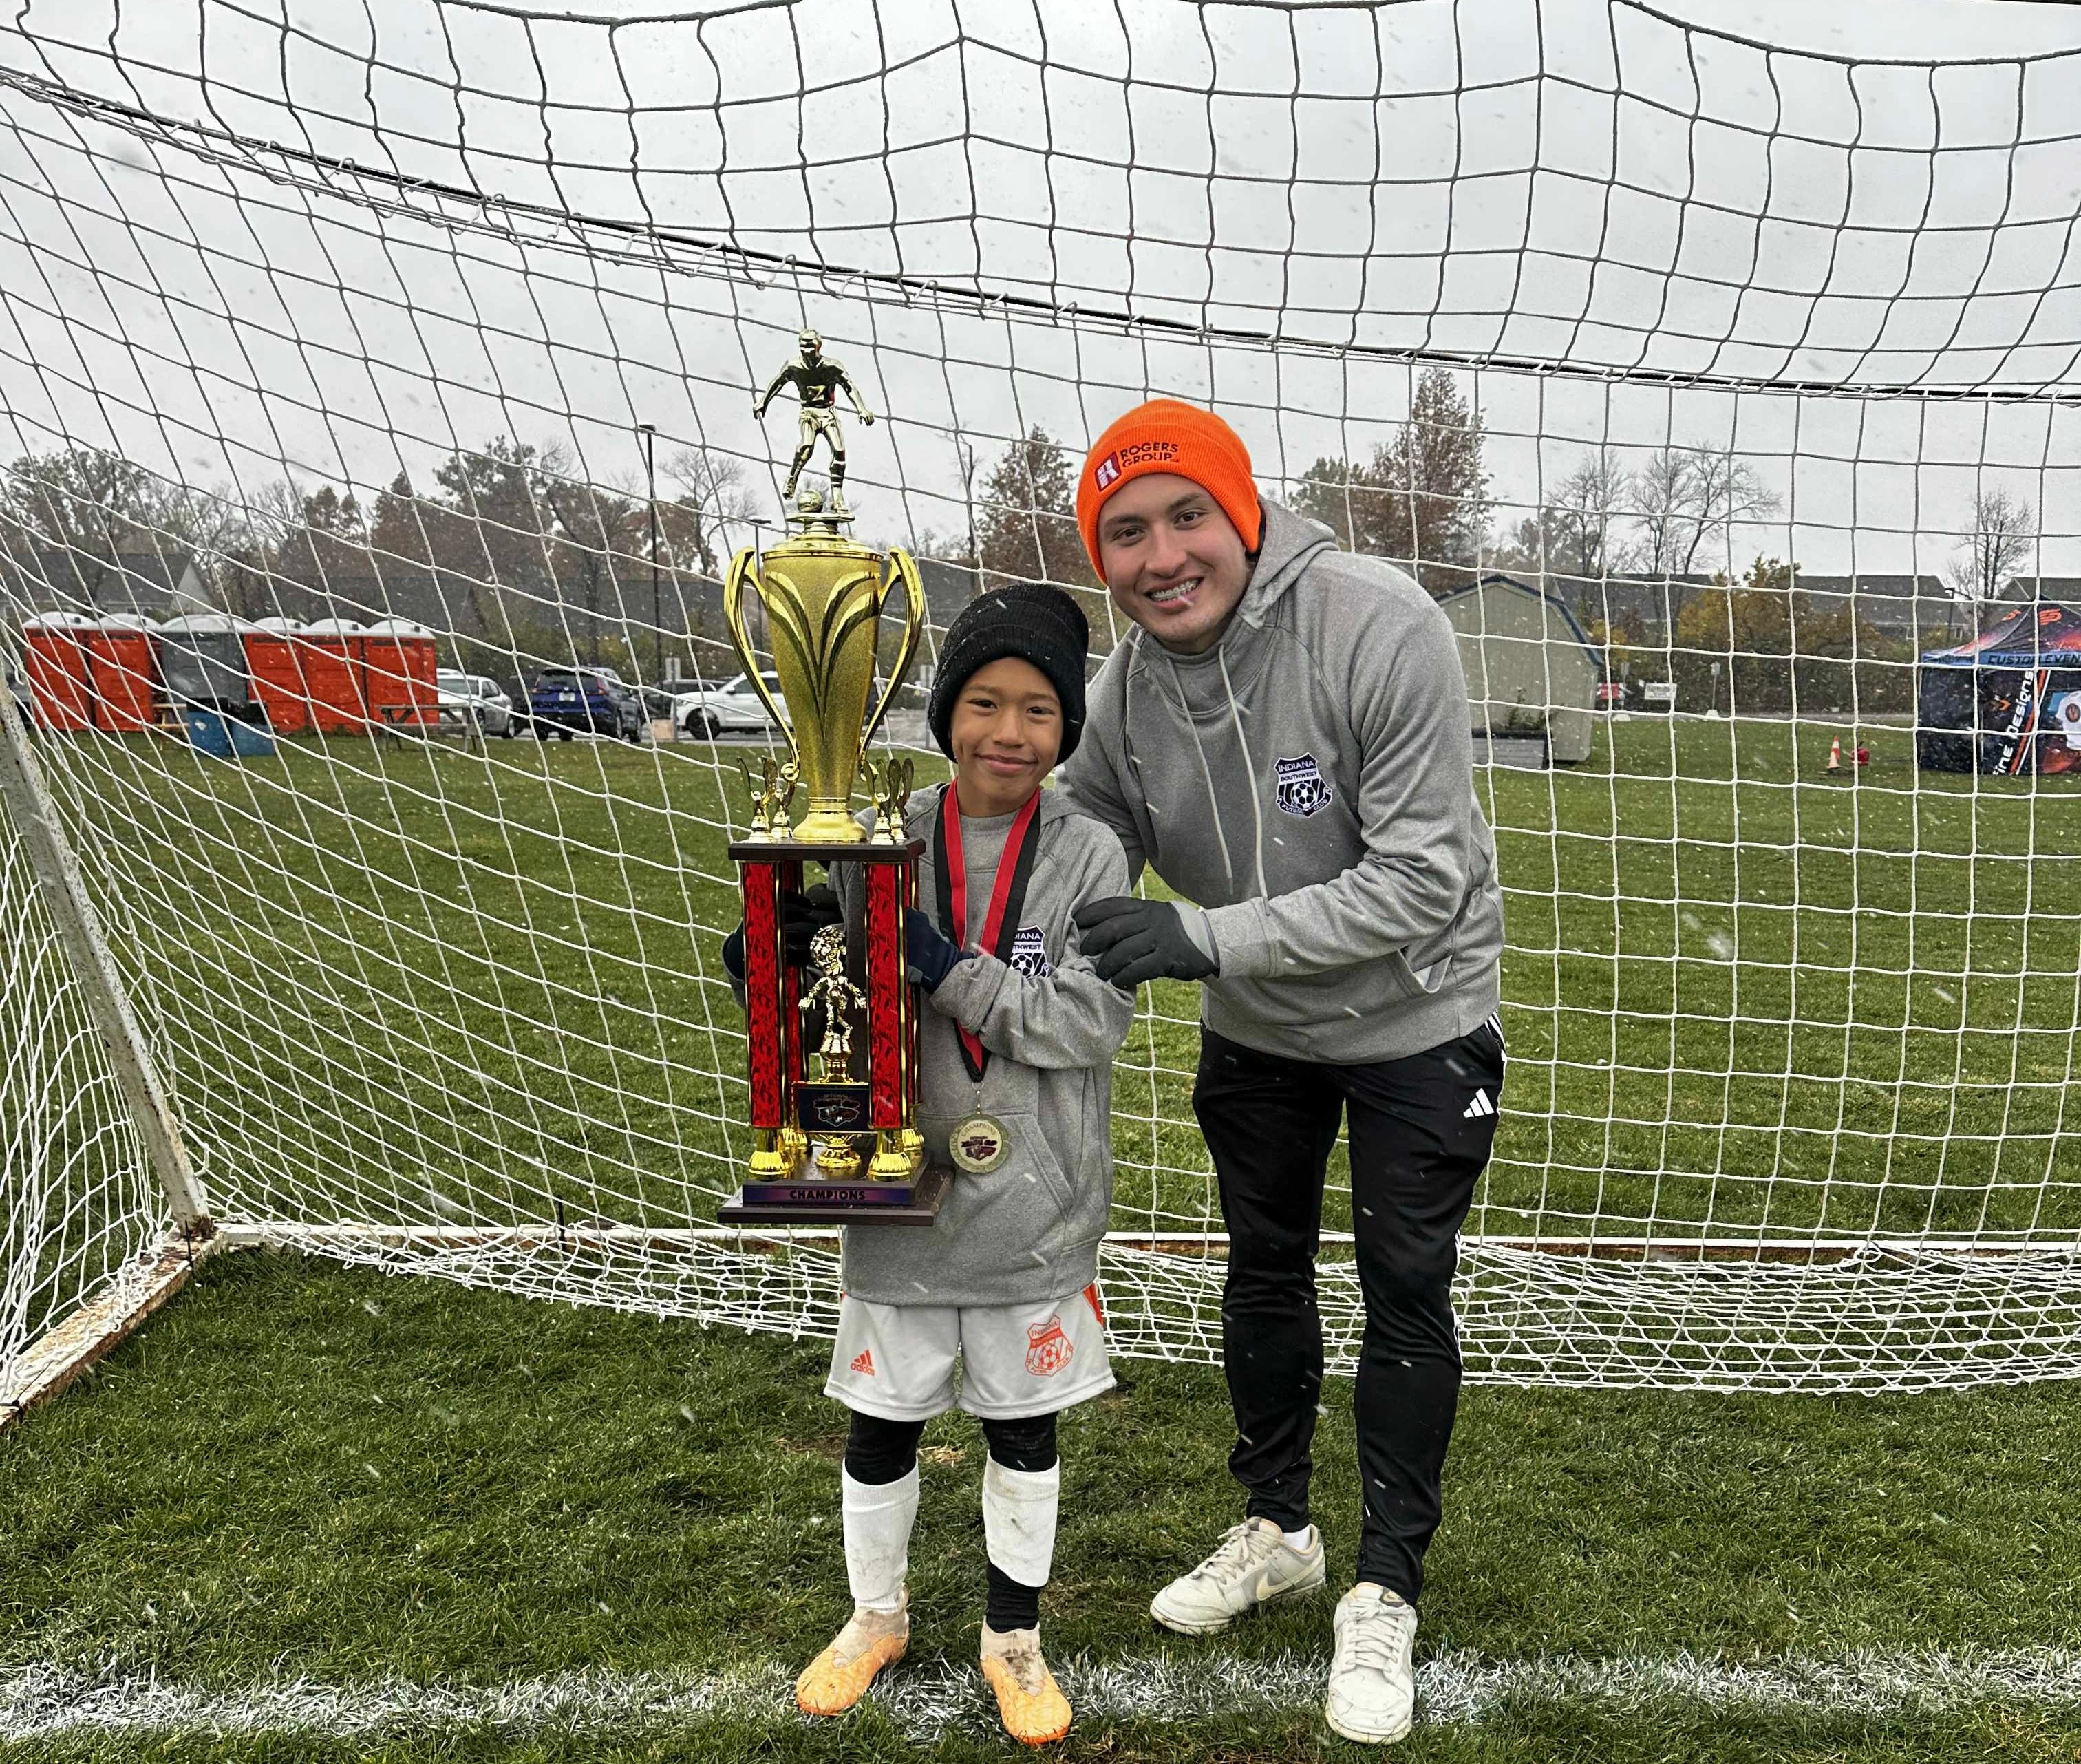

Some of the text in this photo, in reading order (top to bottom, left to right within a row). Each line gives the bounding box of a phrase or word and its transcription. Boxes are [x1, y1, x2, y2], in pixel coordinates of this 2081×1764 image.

[1120, 442, 1179, 460] ROGERS
[1122, 453, 1173, 467] GROUP
[2005, 670, 2034, 740] Designs
[1278, 760, 1315, 772] INDIANA
[1280, 771, 1317, 782] SOUTHWEST
[789, 1189, 866, 1200] CHAMPIONS
